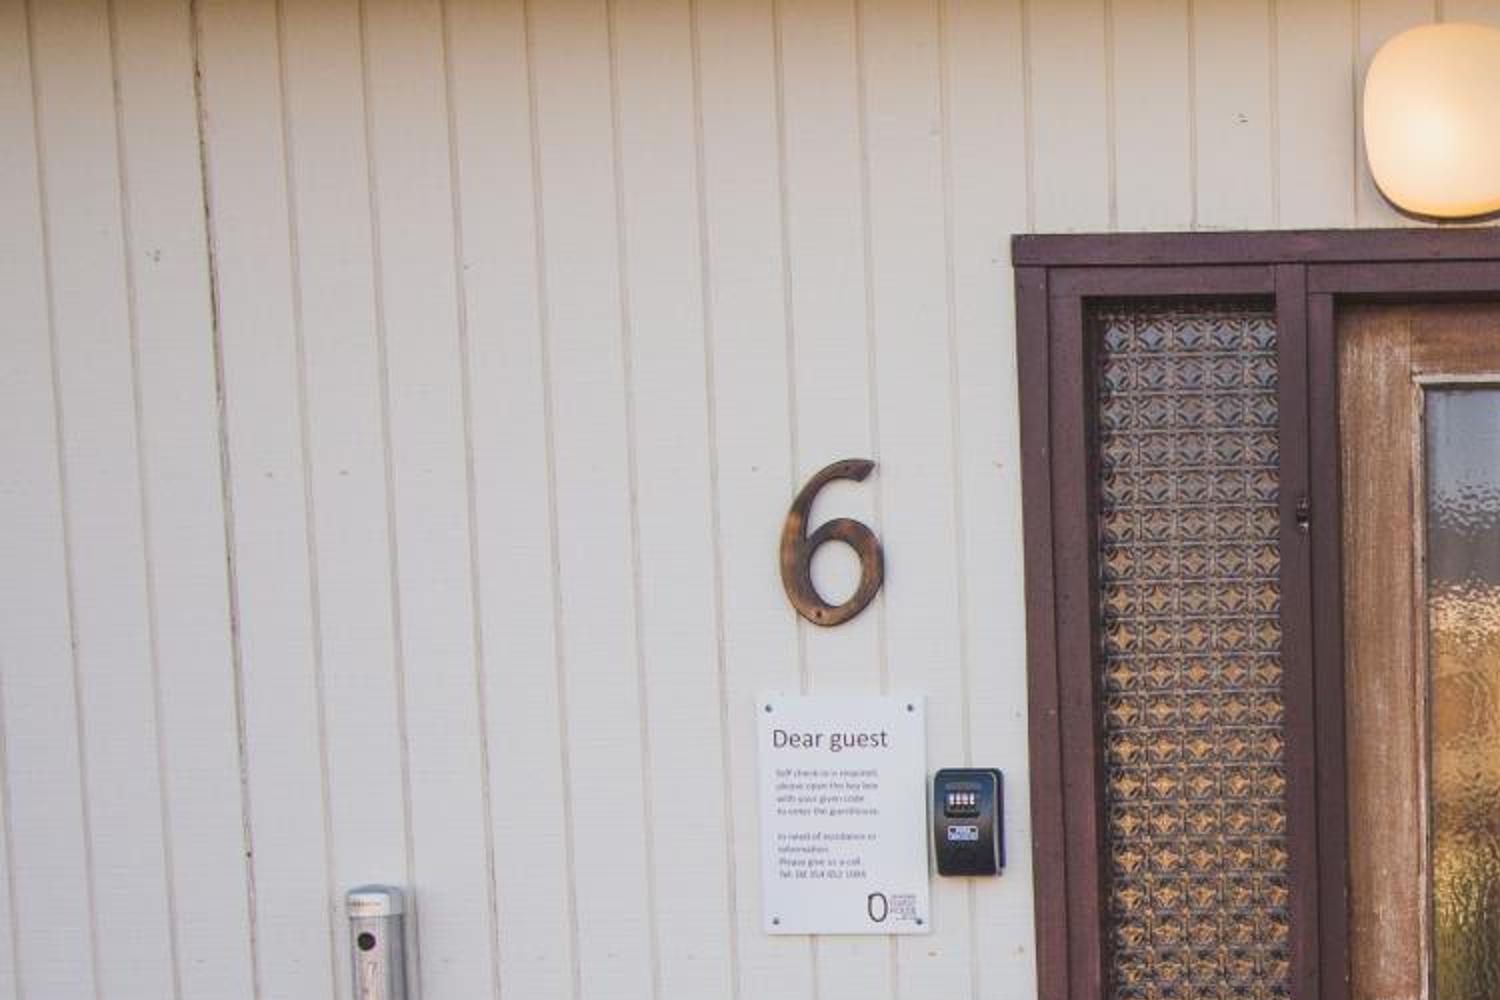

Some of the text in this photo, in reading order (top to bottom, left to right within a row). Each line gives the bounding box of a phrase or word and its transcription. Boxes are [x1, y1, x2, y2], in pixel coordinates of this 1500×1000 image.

[780, 458, 885, 628] 6
[773, 728, 889, 752] Dear guest
